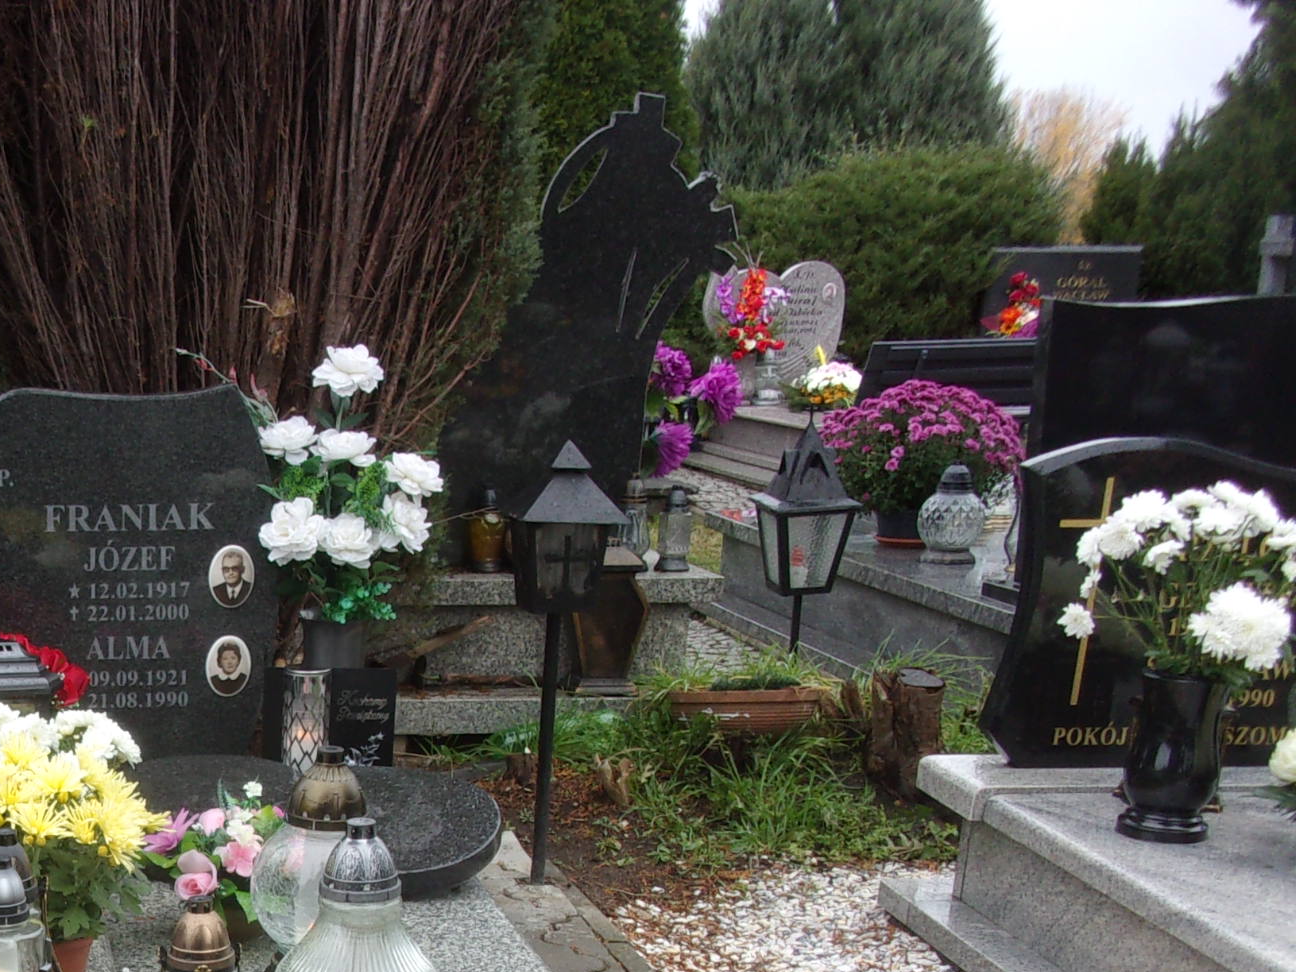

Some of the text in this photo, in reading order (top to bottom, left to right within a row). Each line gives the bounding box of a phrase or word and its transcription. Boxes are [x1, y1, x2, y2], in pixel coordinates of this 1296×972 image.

[44, 502, 216, 533] FRANIAK
[83, 539, 176, 572] JÓZEF
[88, 581, 191, 600] 12.02.1917
[87, 603, 190, 622] 22.01.2000
[86, 634, 171, 661] ALMA
[88, 669, 188, 688] 09.09.1921
[87, 690, 189, 709] 21.08.1990
[1053, 720, 1130, 747] POKÓJ
[1222, 725, 1289, 746] SZOM
